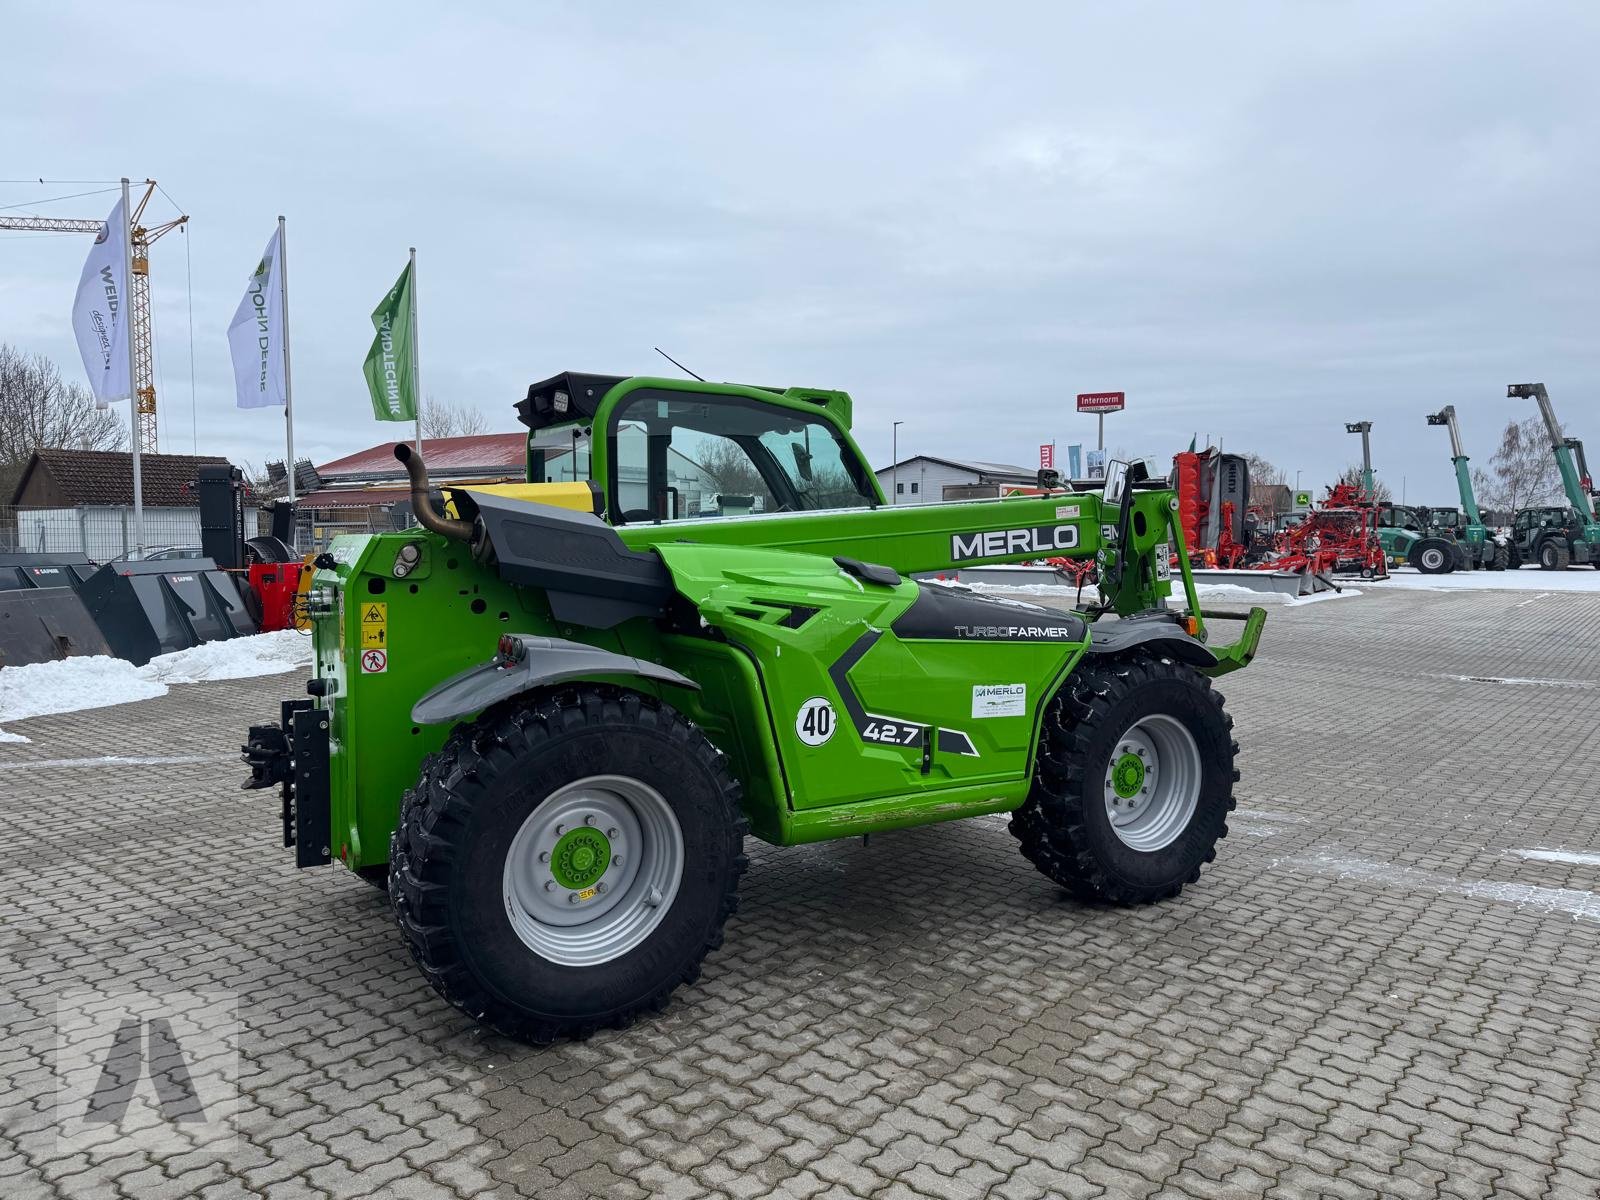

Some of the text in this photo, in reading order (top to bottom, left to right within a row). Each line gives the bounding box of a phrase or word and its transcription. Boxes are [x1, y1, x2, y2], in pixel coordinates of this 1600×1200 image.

[1081, 396, 1119, 405] Internorm
[1228, 463, 1237, 493] KUHN
[952, 524, 1078, 560] MERLO
[954, 625, 1069, 638] TURBOFARMER
[986, 686, 1024, 696] MERLO
[802, 705, 830, 737] 40
[862, 722, 919, 744] 42.7
